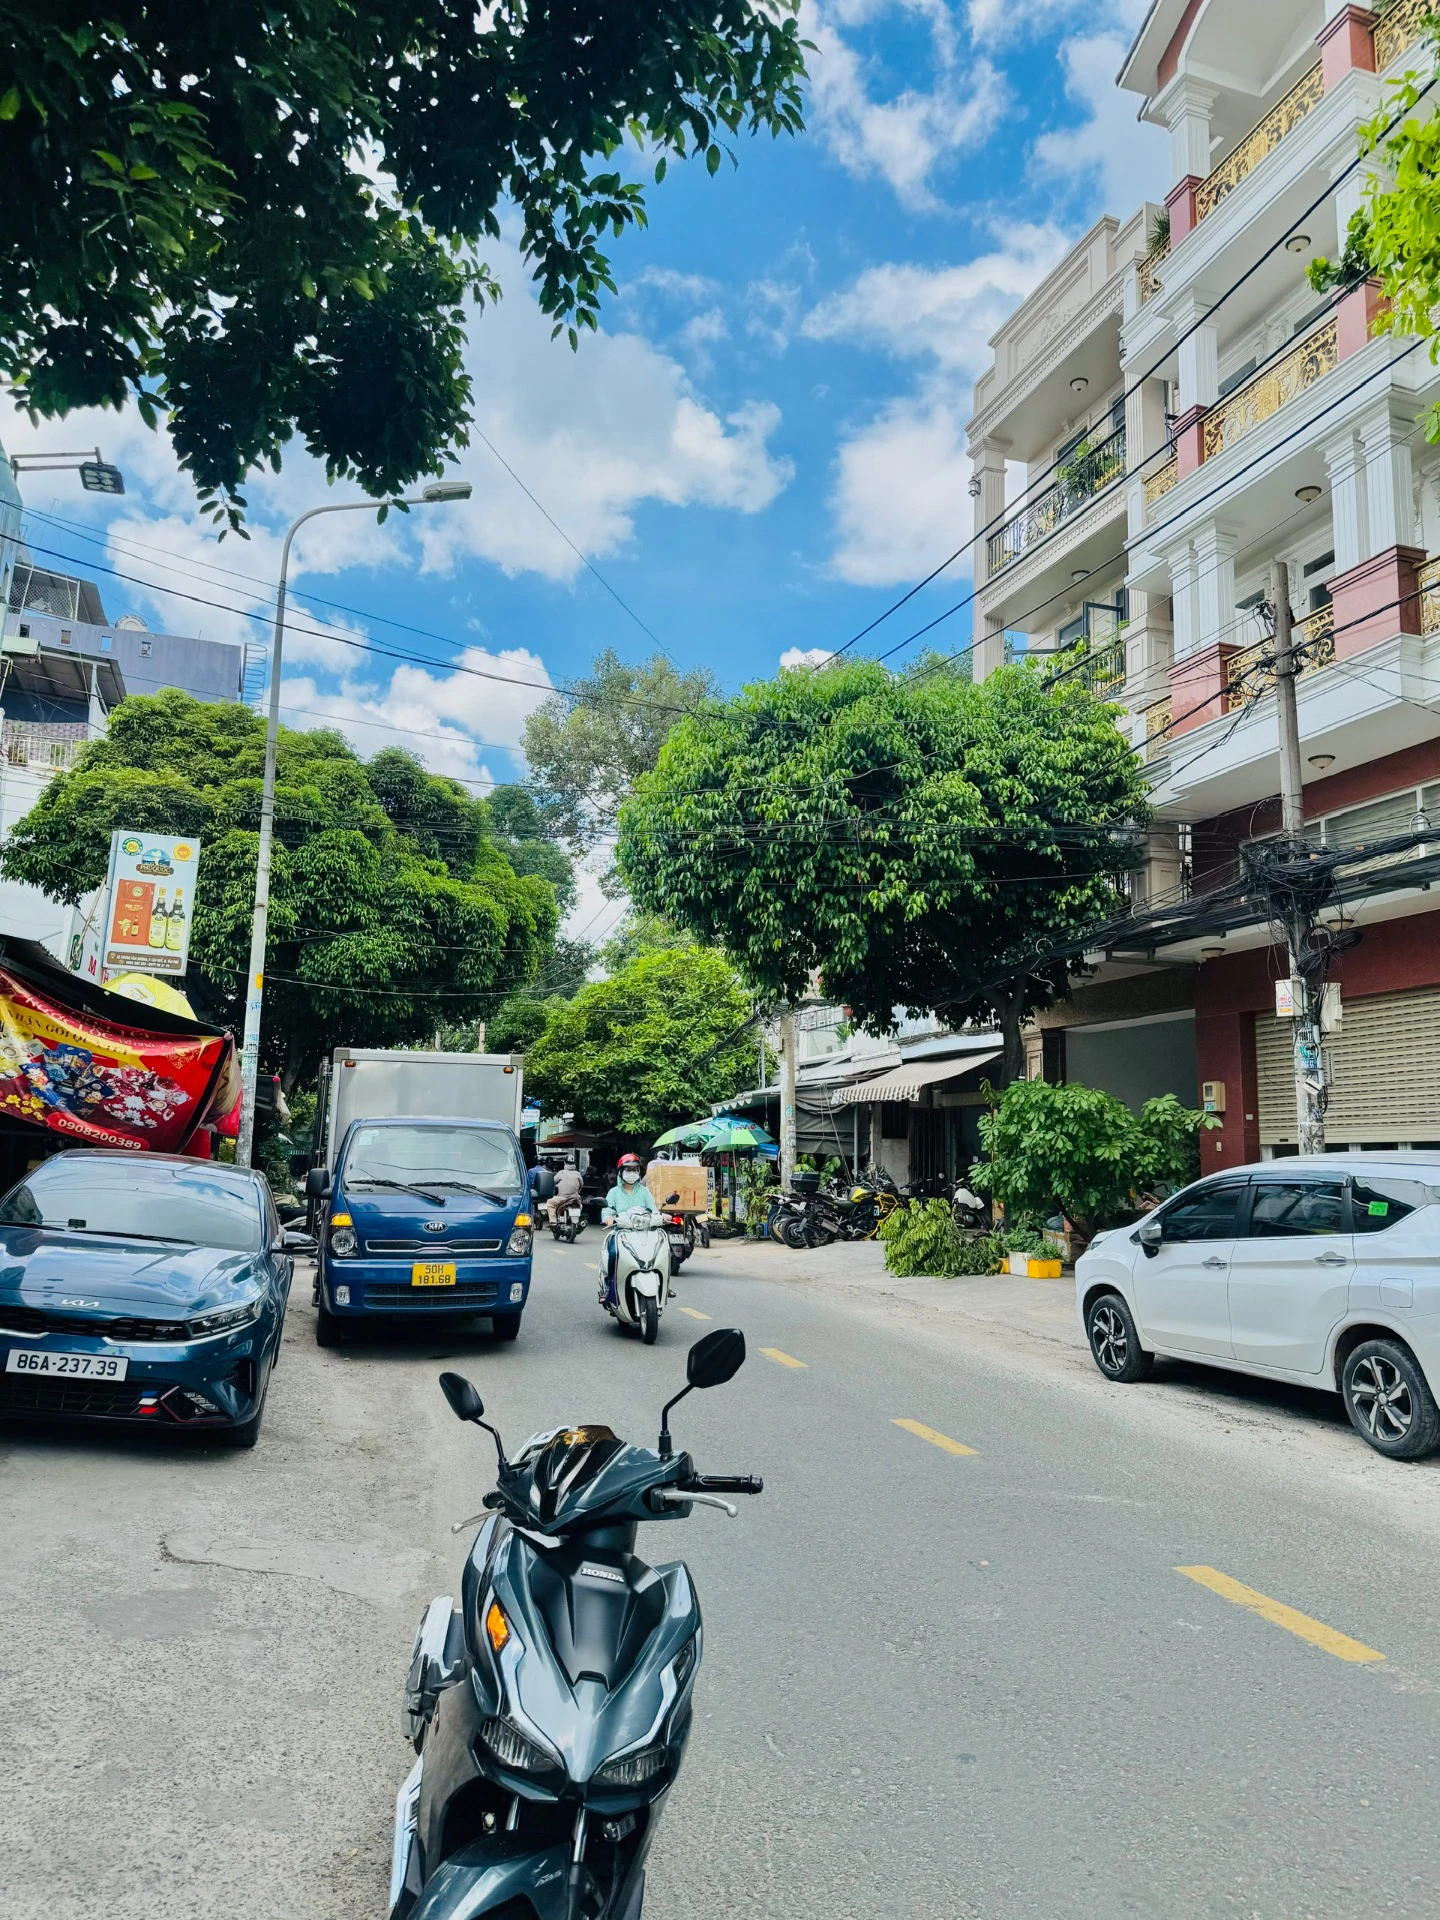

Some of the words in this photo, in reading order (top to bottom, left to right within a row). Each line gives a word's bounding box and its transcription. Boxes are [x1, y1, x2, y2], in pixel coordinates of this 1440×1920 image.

[57, 1118, 142, 1150] 0908200389
[425, 1265, 444, 1274] 50H
[418, 1275, 451, 1284] 181.68
[17, 1354, 118, 1377] 86A-237.39
[581, 1567, 625, 1584] HONDA
